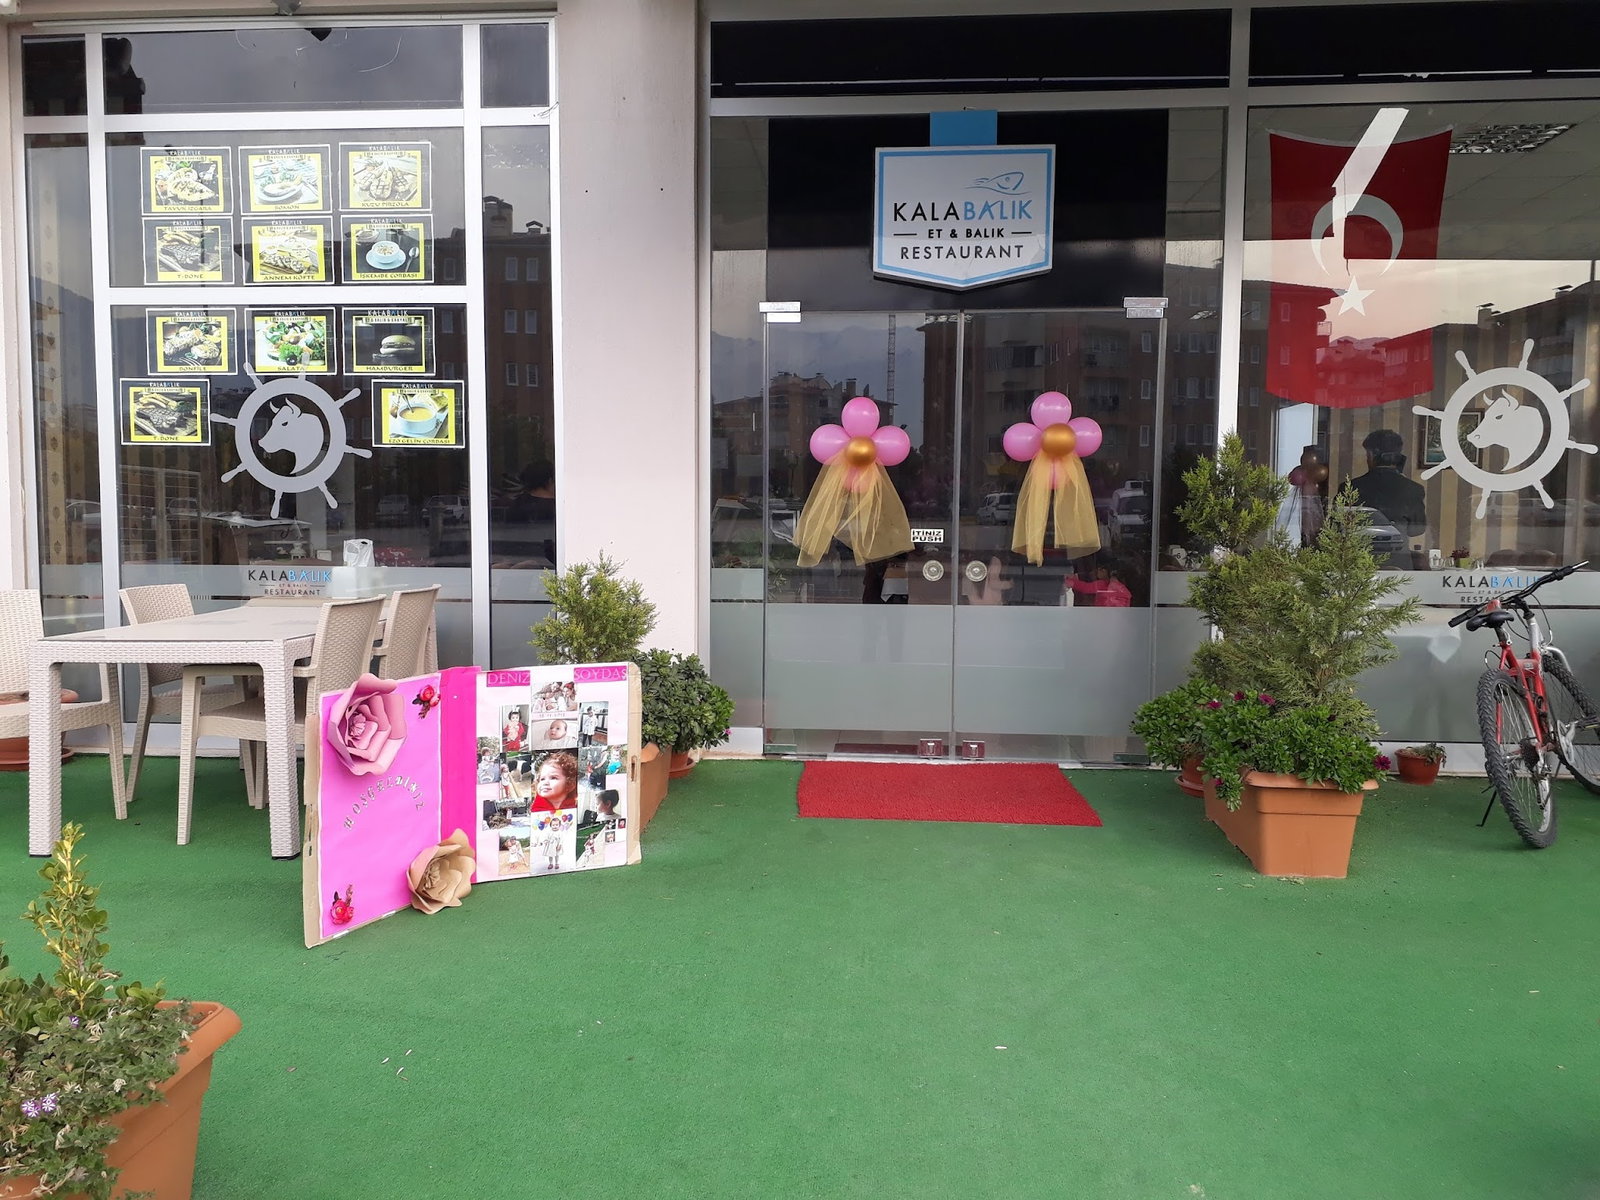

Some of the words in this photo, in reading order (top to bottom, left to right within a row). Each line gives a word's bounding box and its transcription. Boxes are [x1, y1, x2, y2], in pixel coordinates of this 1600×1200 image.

[893, 200, 1033, 222] KALABALIK
[927, 229, 942, 239] ET
[950, 229, 958, 239] &
[965, 228, 1005, 239] BALIK
[900, 245, 1024, 260] RESTAURANT
[248, 569, 333, 583] KALABALIK
